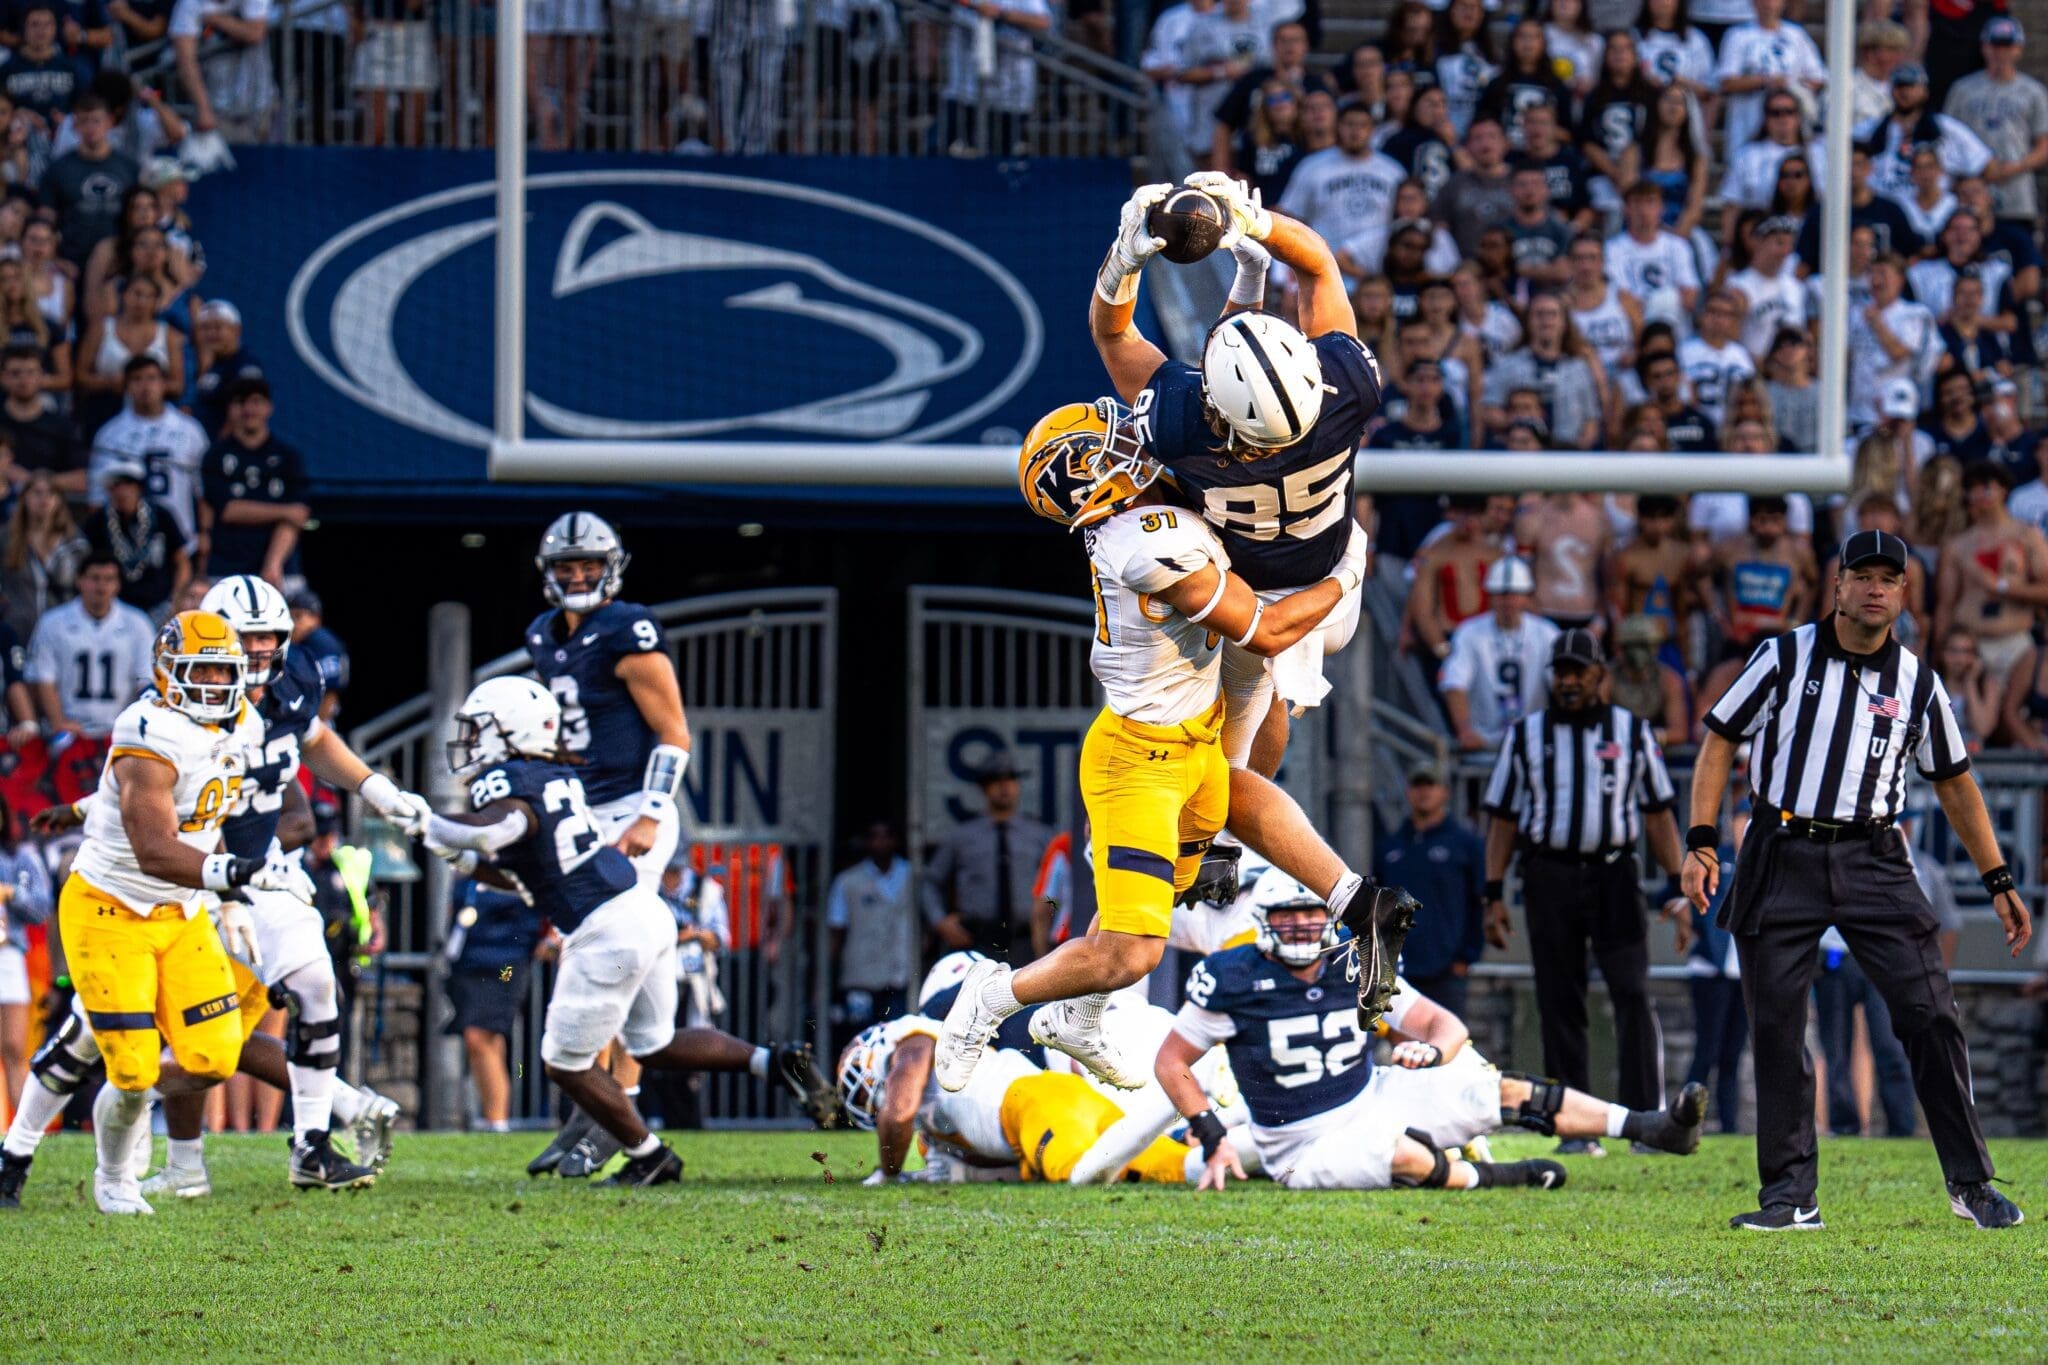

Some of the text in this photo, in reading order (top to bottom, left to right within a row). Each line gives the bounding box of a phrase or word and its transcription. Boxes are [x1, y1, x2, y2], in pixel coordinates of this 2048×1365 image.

[1202, 446, 1352, 541] 85
[1140, 510, 1178, 533] 31
[632, 619, 659, 650] 9
[74, 651, 116, 700] 11
[1499, 660, 1522, 702] 9
[1805, 679, 1820, 695] S
[1870, 736, 1887, 758] U
[470, 769, 512, 809] 26
[1185, 961, 1217, 1007] 52
[1267, 1007, 1368, 1089] 52
